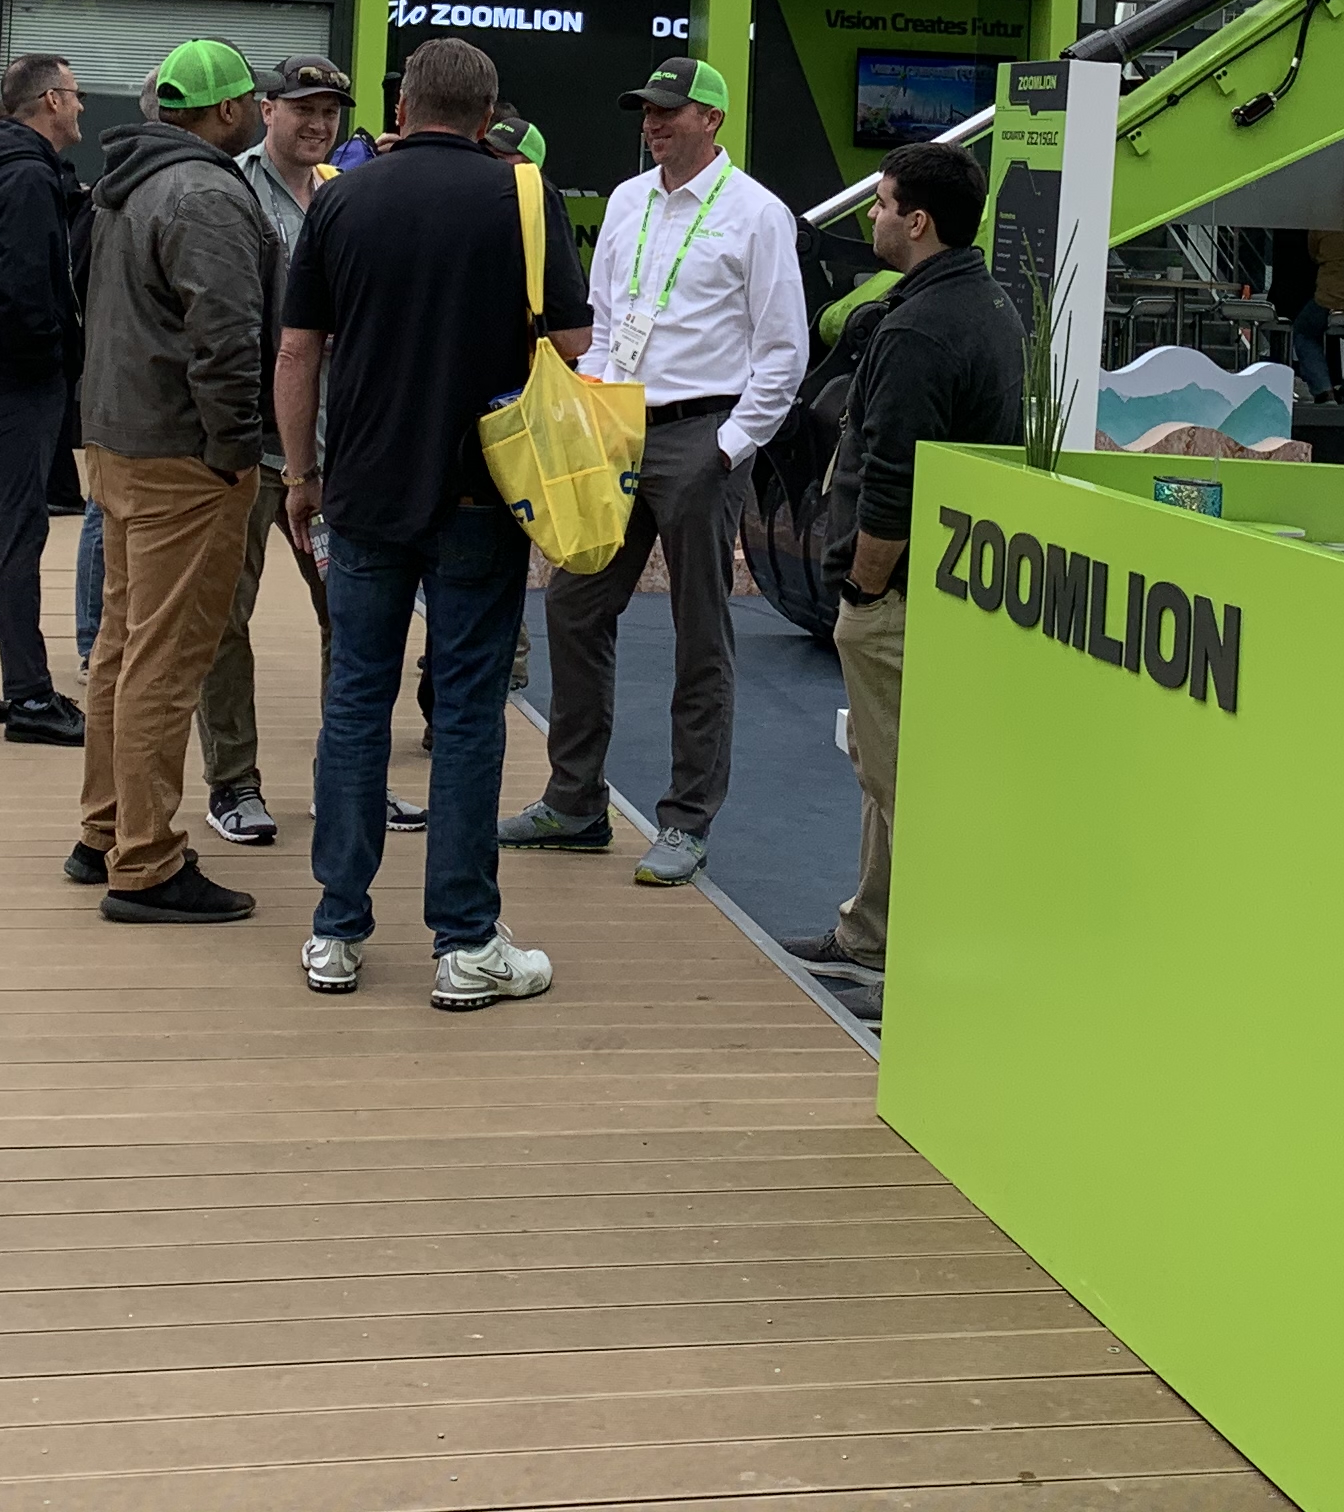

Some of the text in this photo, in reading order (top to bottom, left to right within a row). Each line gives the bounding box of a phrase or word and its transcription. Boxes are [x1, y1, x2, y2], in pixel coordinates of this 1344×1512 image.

[430, 3, 583, 34] ZOOMLION
[825, 9, 1025, 39] Vision Creates Futur
[1018, 75, 1058, 91] ZOOMLION
[935, 504, 1241, 715] ZOOMLION
